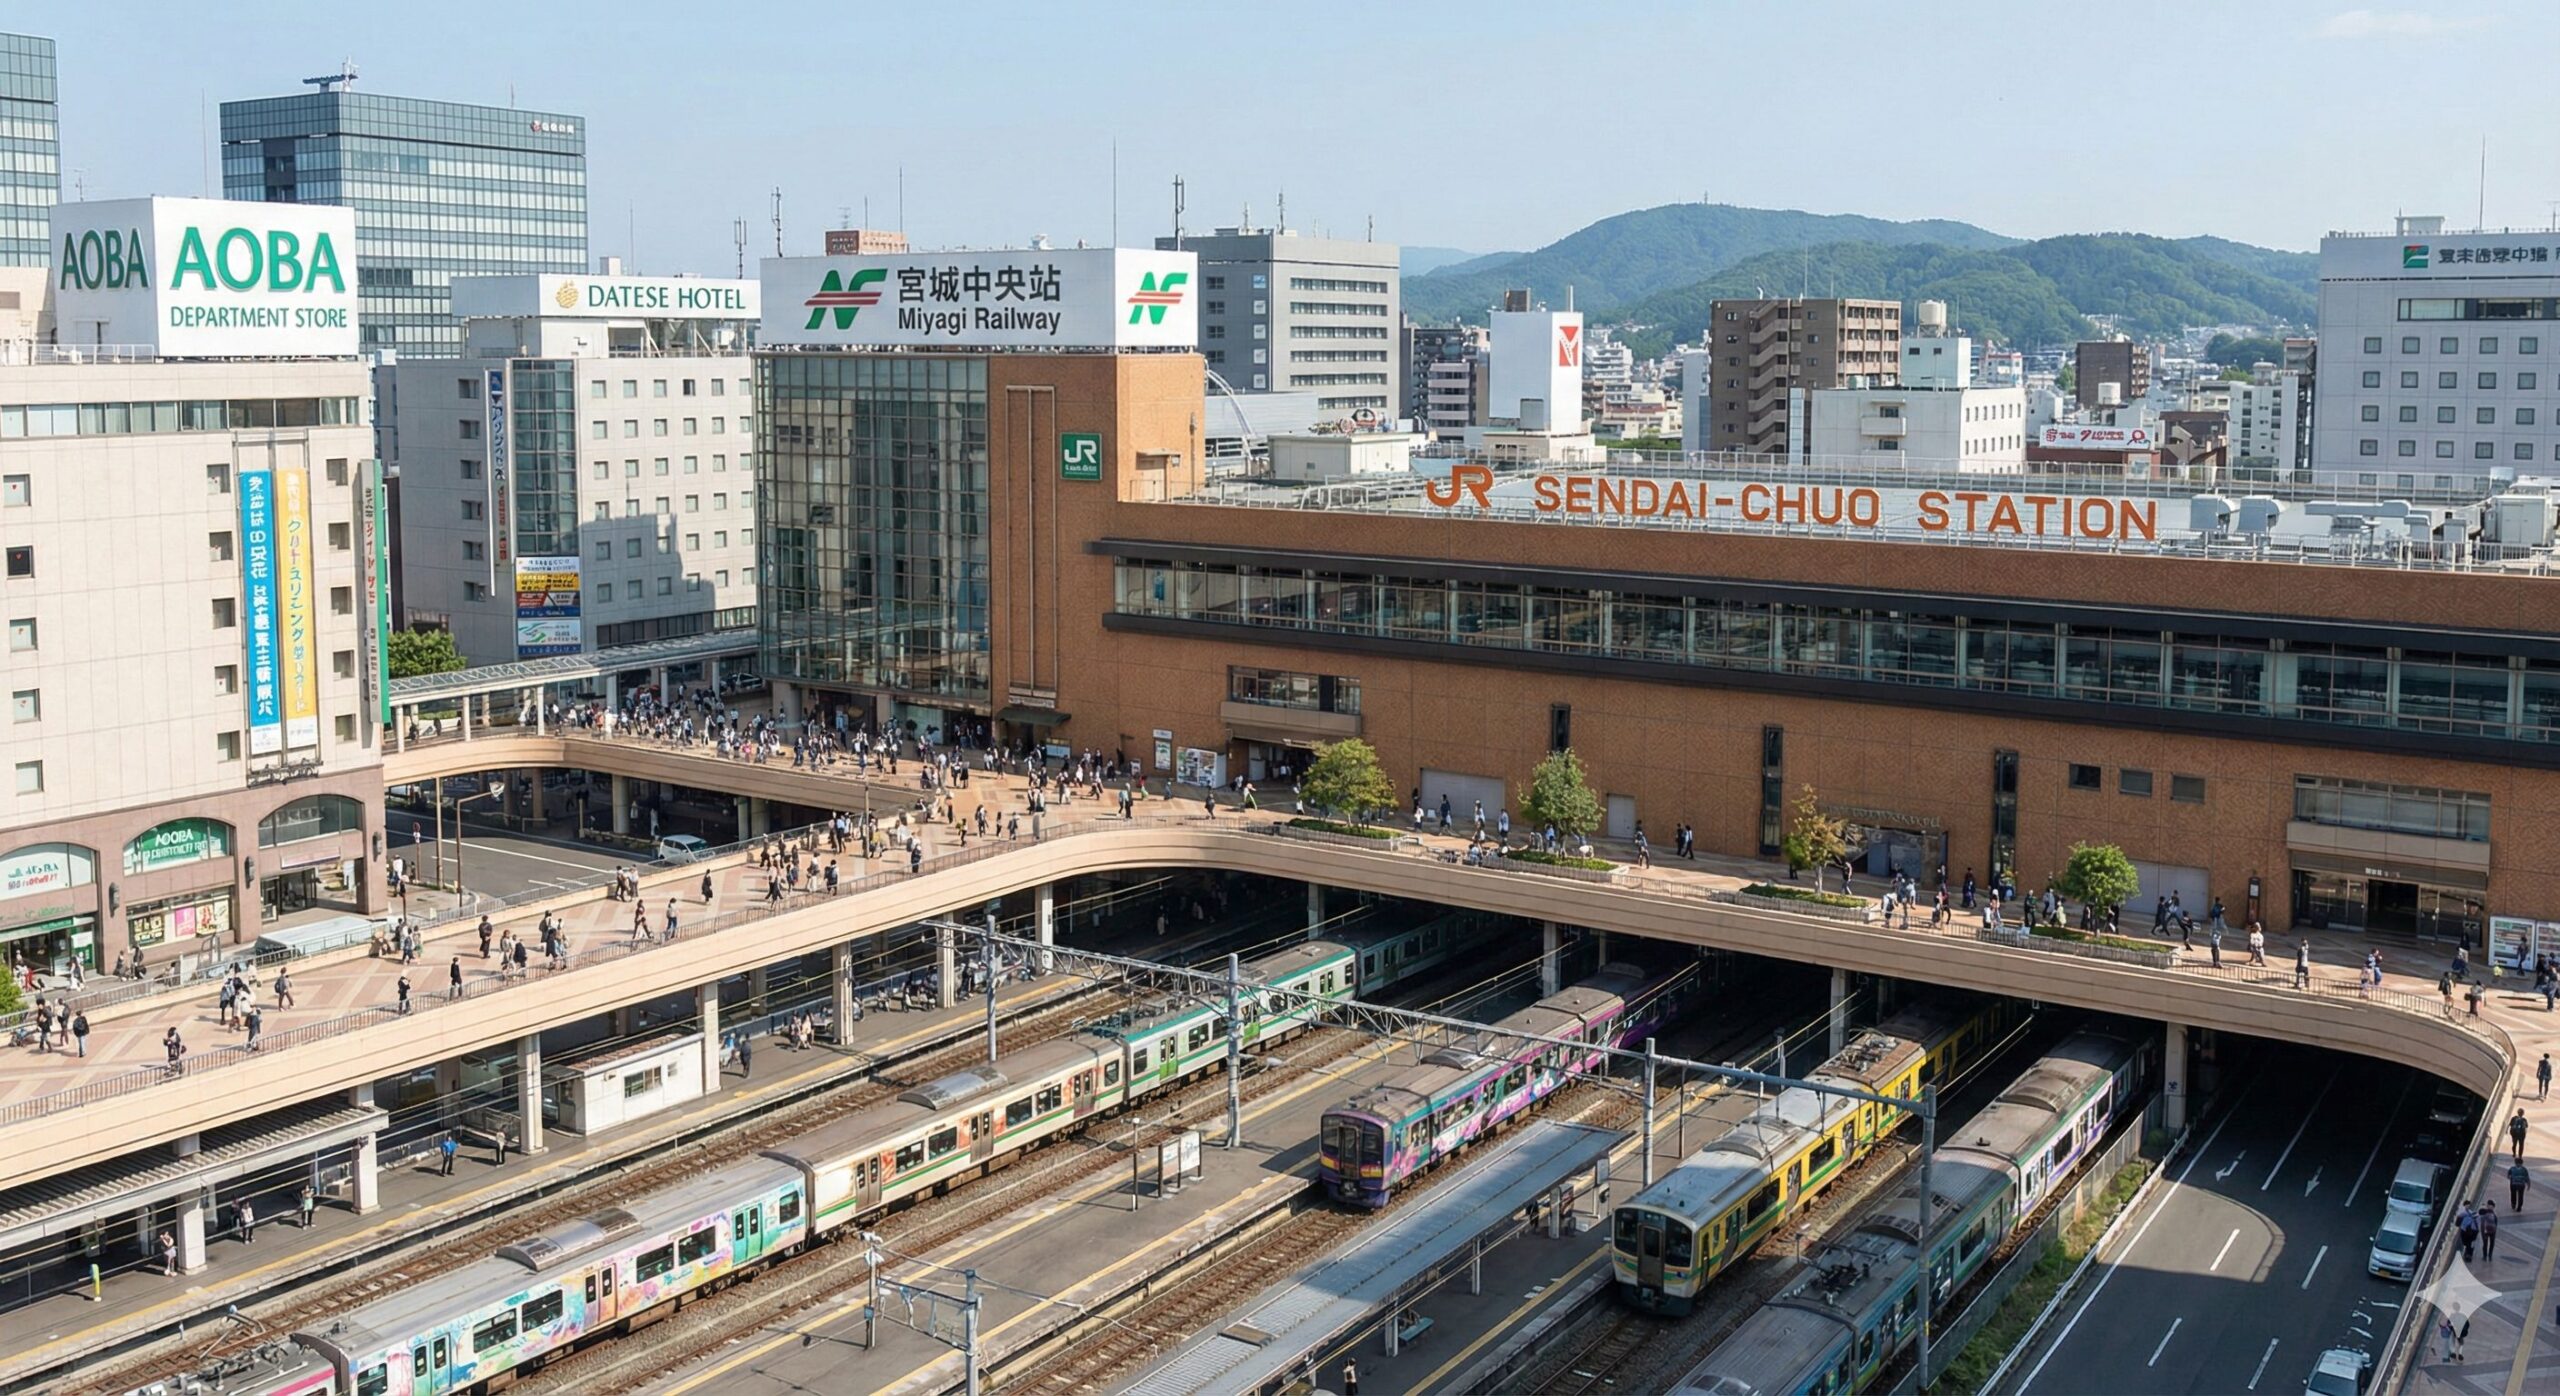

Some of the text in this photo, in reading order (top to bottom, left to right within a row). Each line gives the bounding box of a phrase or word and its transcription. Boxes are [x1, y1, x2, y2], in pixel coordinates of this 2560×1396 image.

[60, 228, 149, 290] AOBA
[170, 226, 346, 293] AOBA
[588, 285, 746, 309] DATESE HOTEL
[897, 264, 1062, 303] 宮城中央站
[170, 306, 347, 329] DEPARTMENT STORE
[899, 306, 1062, 336] Miyagi Railway
[1064, 440, 1097, 463] JR
[1426, 464, 2157, 542] JR SENDAI-CHUO STATION
